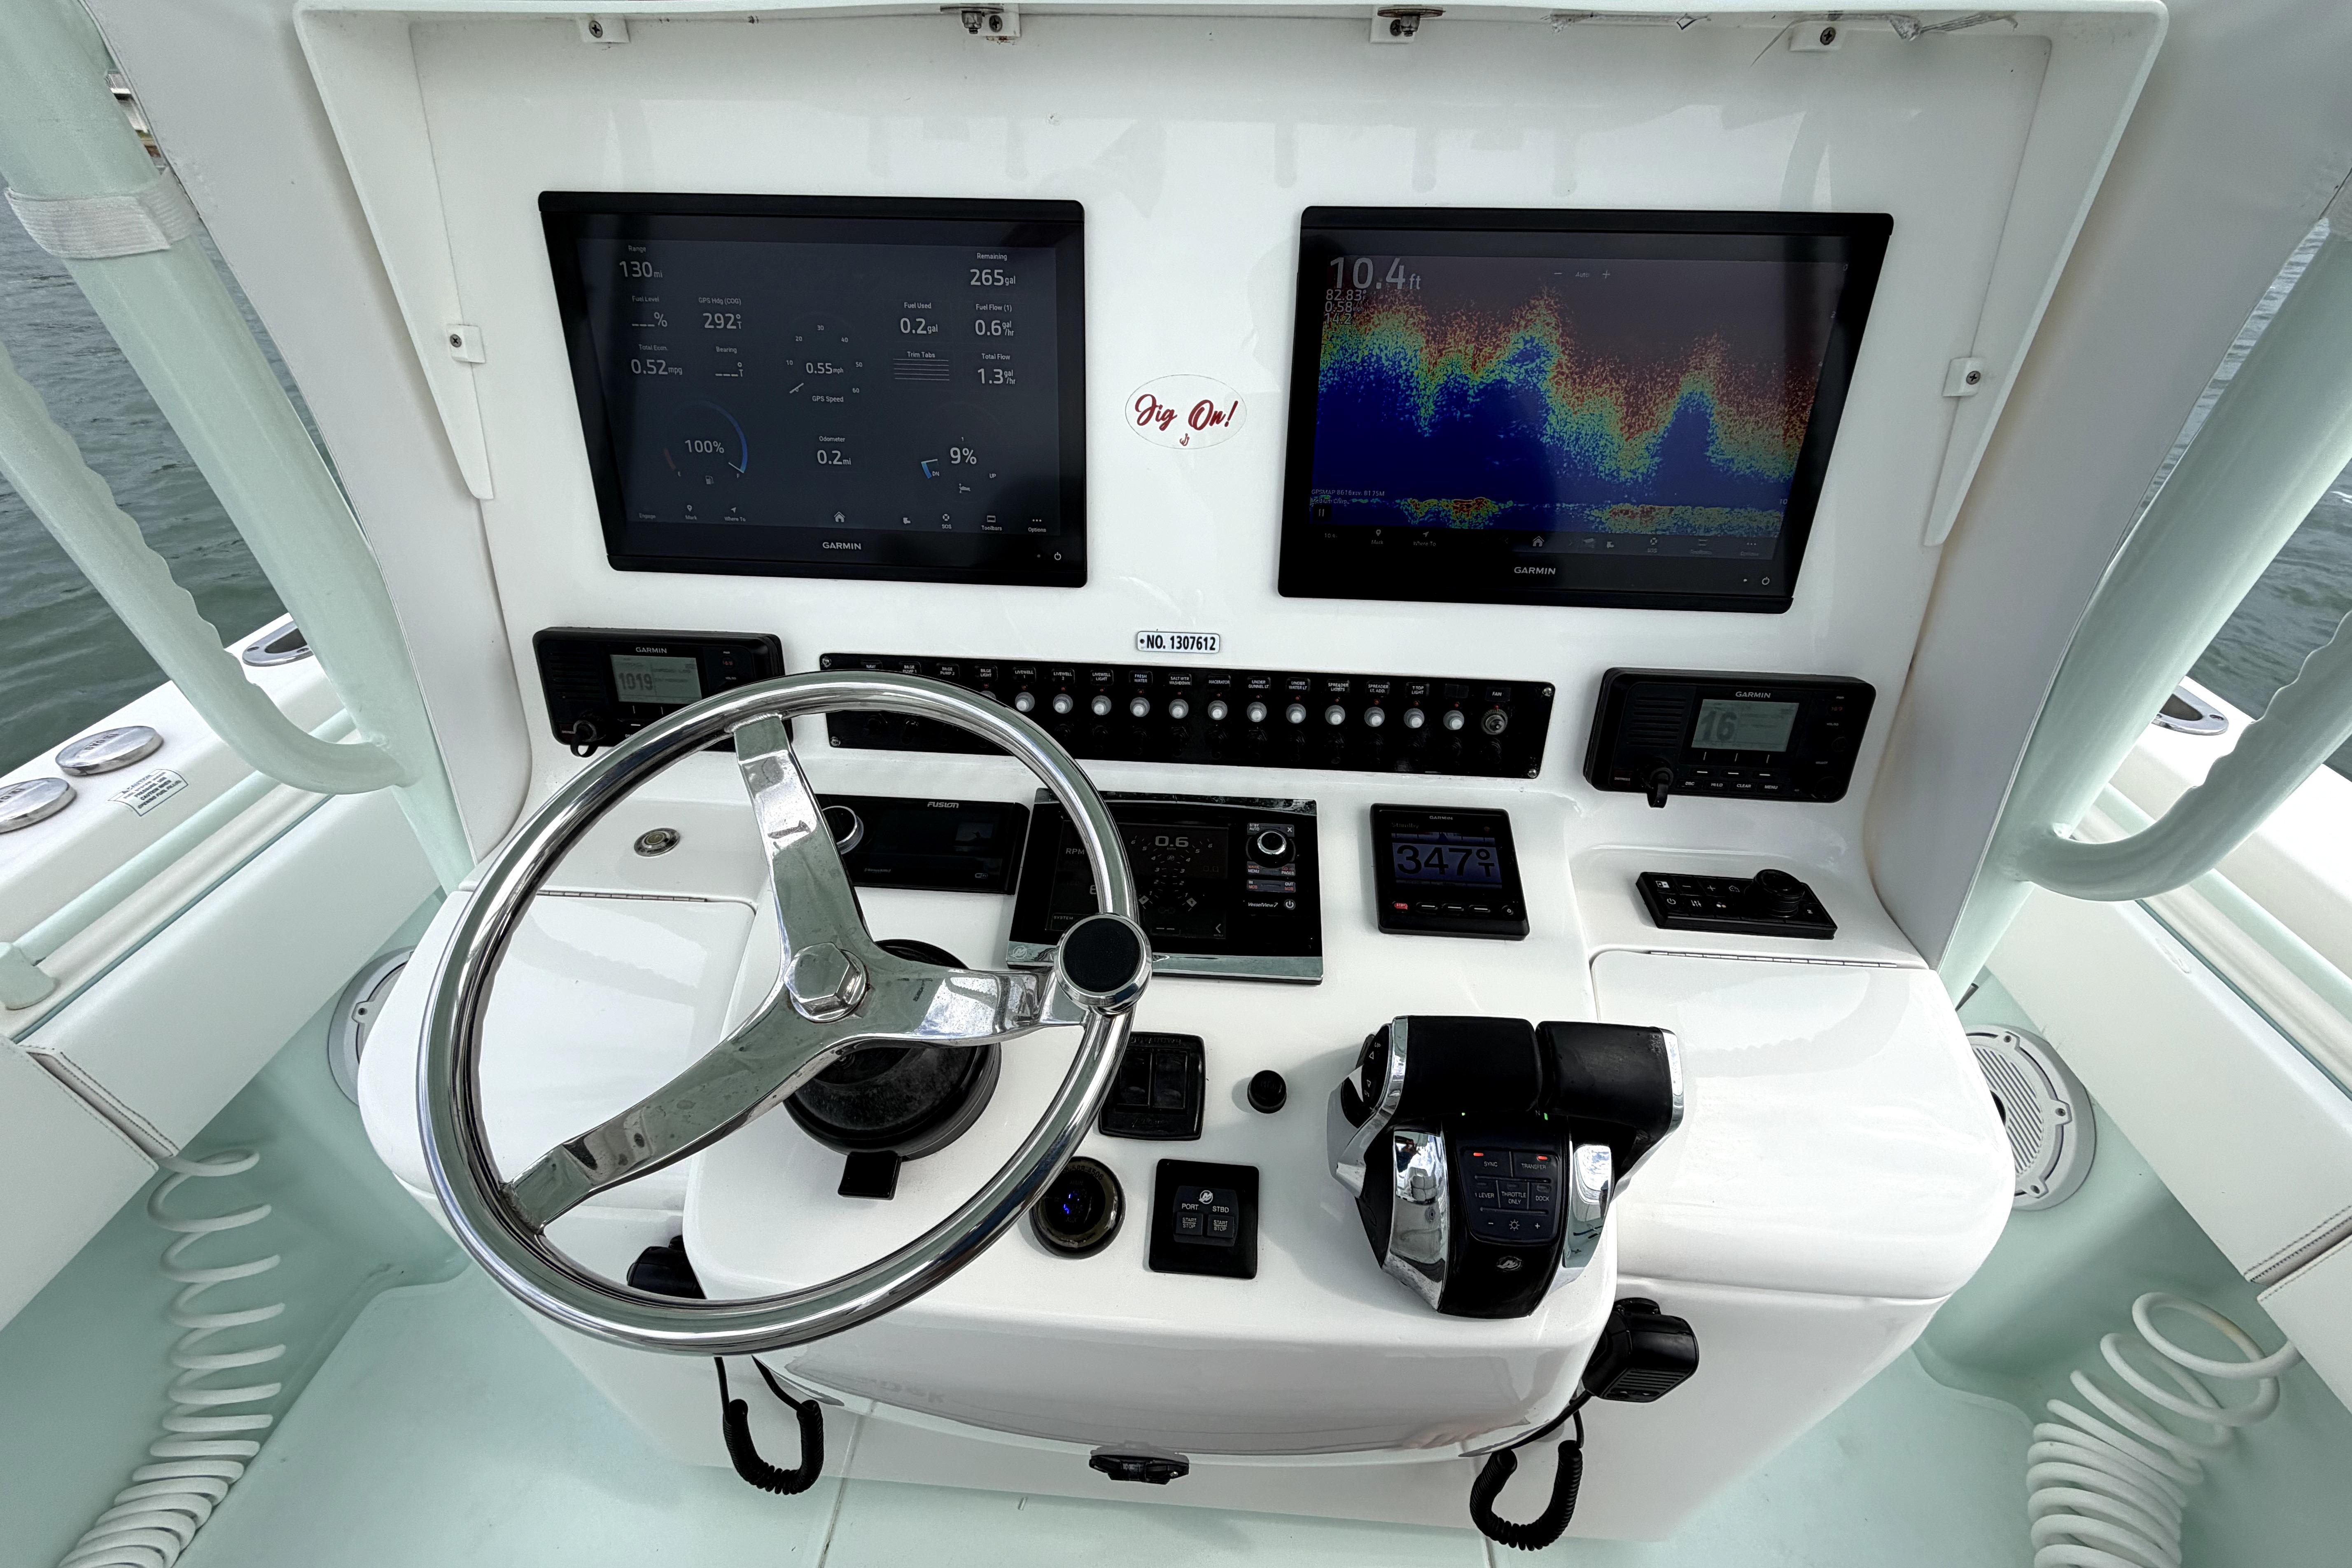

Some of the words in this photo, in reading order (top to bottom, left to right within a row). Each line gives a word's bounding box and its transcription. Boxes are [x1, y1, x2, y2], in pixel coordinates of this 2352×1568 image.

[725, 297, 741, 306] (COG)
[1135, 394, 1178, 431] Jig
[1188, 399, 1238, 430] On!
[685, 439, 724, 454] 100%
[950, 447, 977, 465] 9%
[1514, 566, 1556, 575] GARMIN
[1147, 635, 1165, 649] NO.
[1170, 636, 1216, 650] 1307612
[619, 672, 653, 690] 1019
[1700, 711, 1737, 741] 16
[1155, 836, 1189, 847] 0.6
